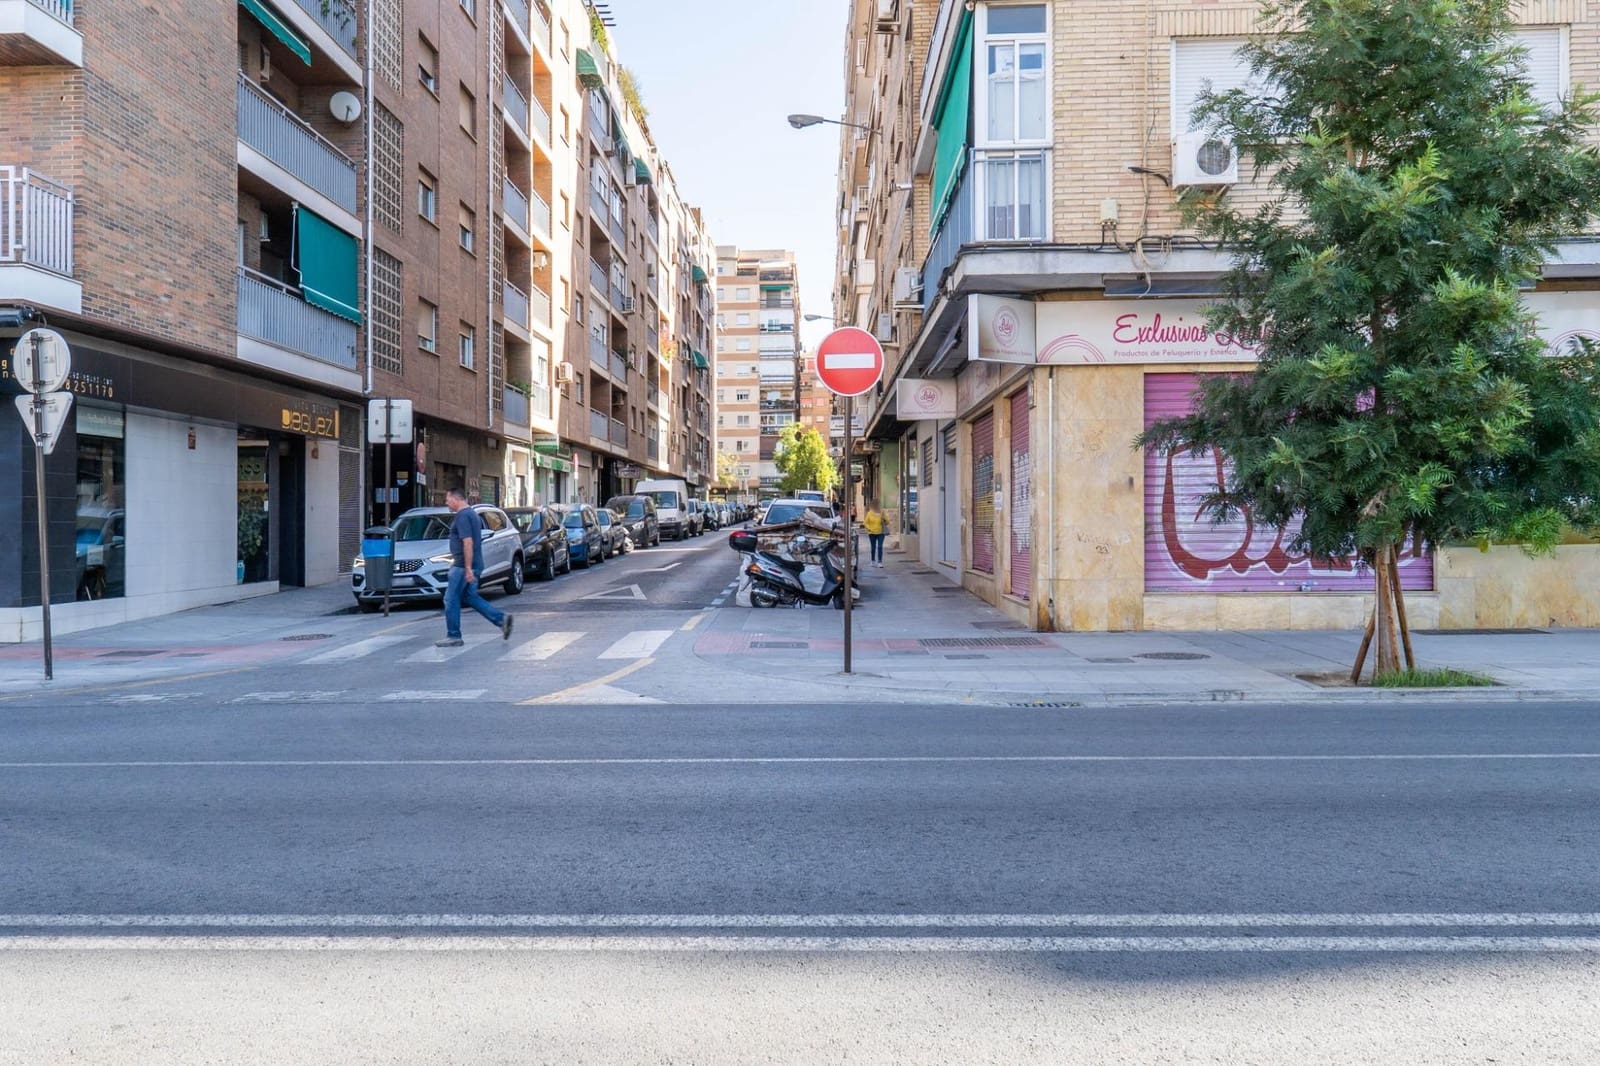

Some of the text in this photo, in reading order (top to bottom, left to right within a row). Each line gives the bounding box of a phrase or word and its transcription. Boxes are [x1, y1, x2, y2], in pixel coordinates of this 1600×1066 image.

[1113, 312, 1208, 344] Exclusivas
[1113, 349, 1149, 358] Productos
[1150, 349, 1160, 357] de
